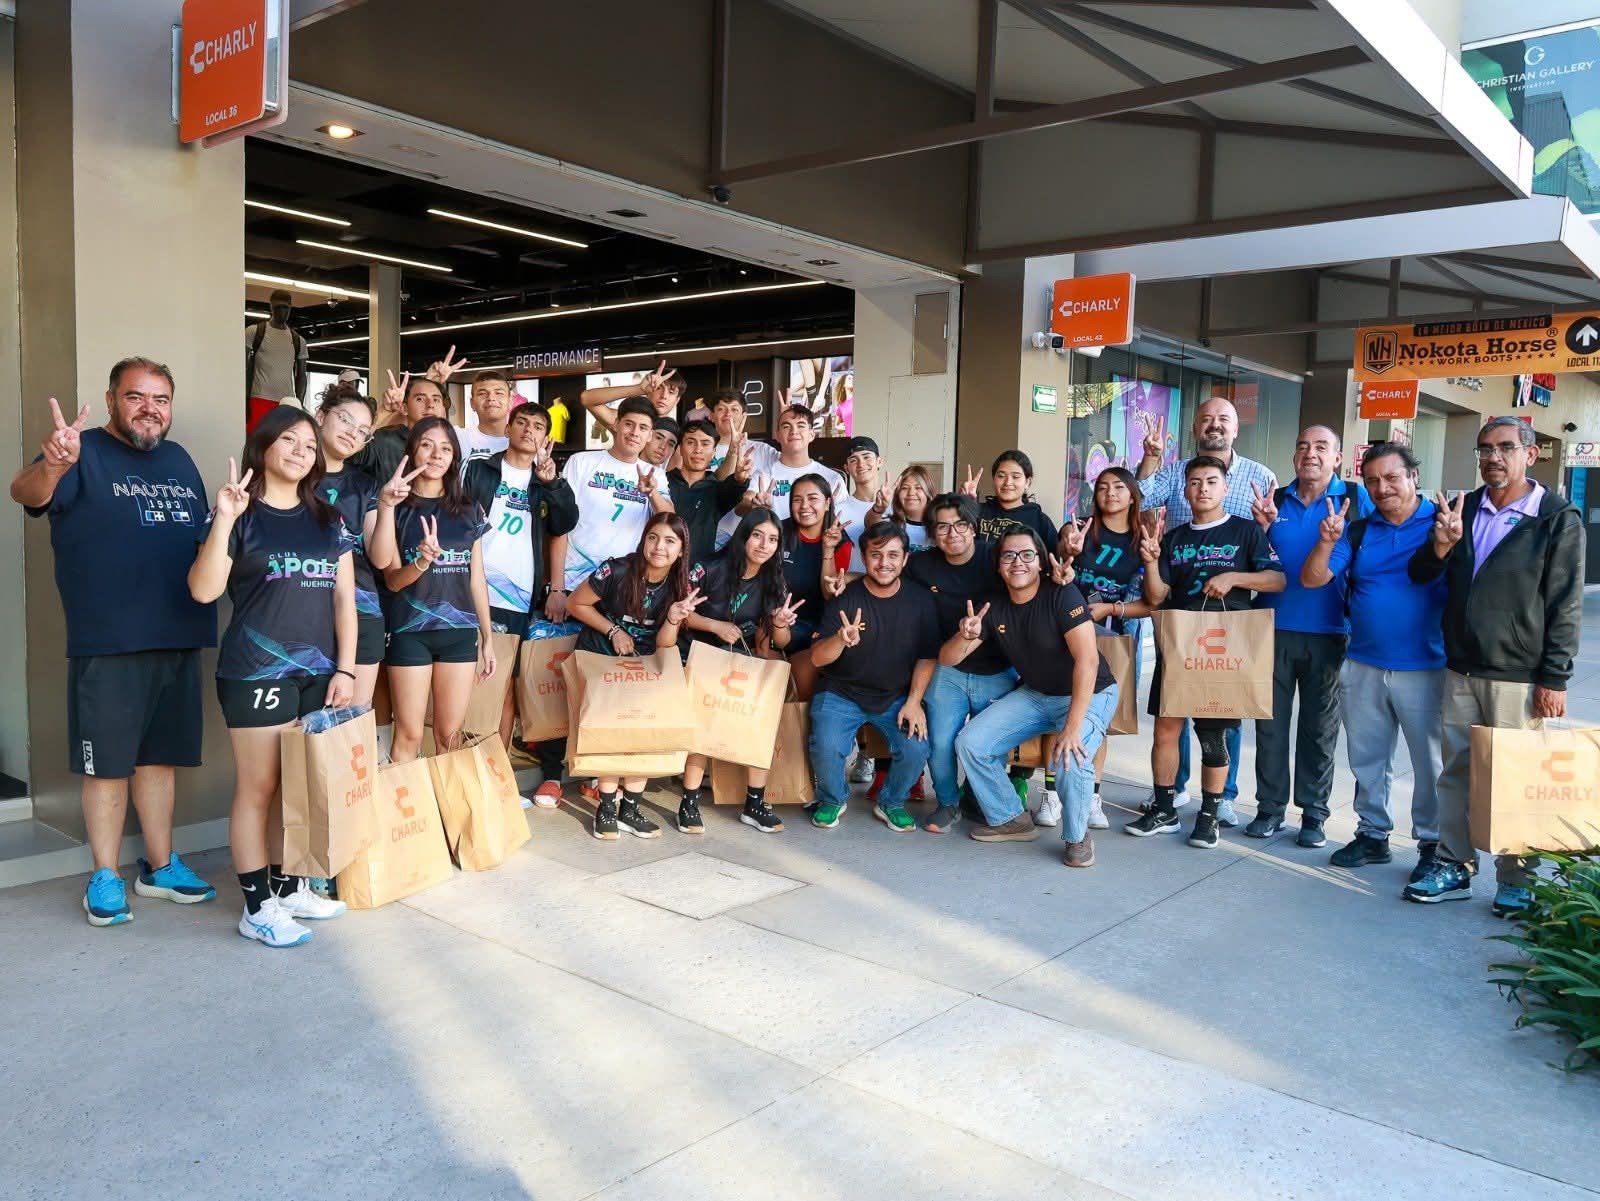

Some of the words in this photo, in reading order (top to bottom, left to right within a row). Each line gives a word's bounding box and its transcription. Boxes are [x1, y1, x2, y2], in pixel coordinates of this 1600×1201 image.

[205, 21, 258, 65] CHARLY
[1539, 60, 1595, 78] GALLERY
[205, 111, 228, 126] LOCAL
[1073, 297, 1121, 314] CHARLY
[1399, 342, 1479, 359] Nokota
[1486, 338, 1557, 354] Horse
[516, 348, 599, 369] PERFORMANCE
[1437, 356, 1470, 365] WORK
[1475, 354, 1513, 363] BOOTS
[1567, 357, 1591, 368] LOCAL
[1376, 390, 1411, 399] CHARLY
[112, 482, 198, 500] NAUTICA
[498, 512, 524, 536] 10
[1184, 657, 1243, 671] CHARLY
[603, 671, 663, 683] CHARLY
[253, 687, 281, 710] 15
[703, 693, 758, 716] CHARLY
[1524, 785, 1593, 800] CHARLY
[391, 817, 428, 843] CHARLY
